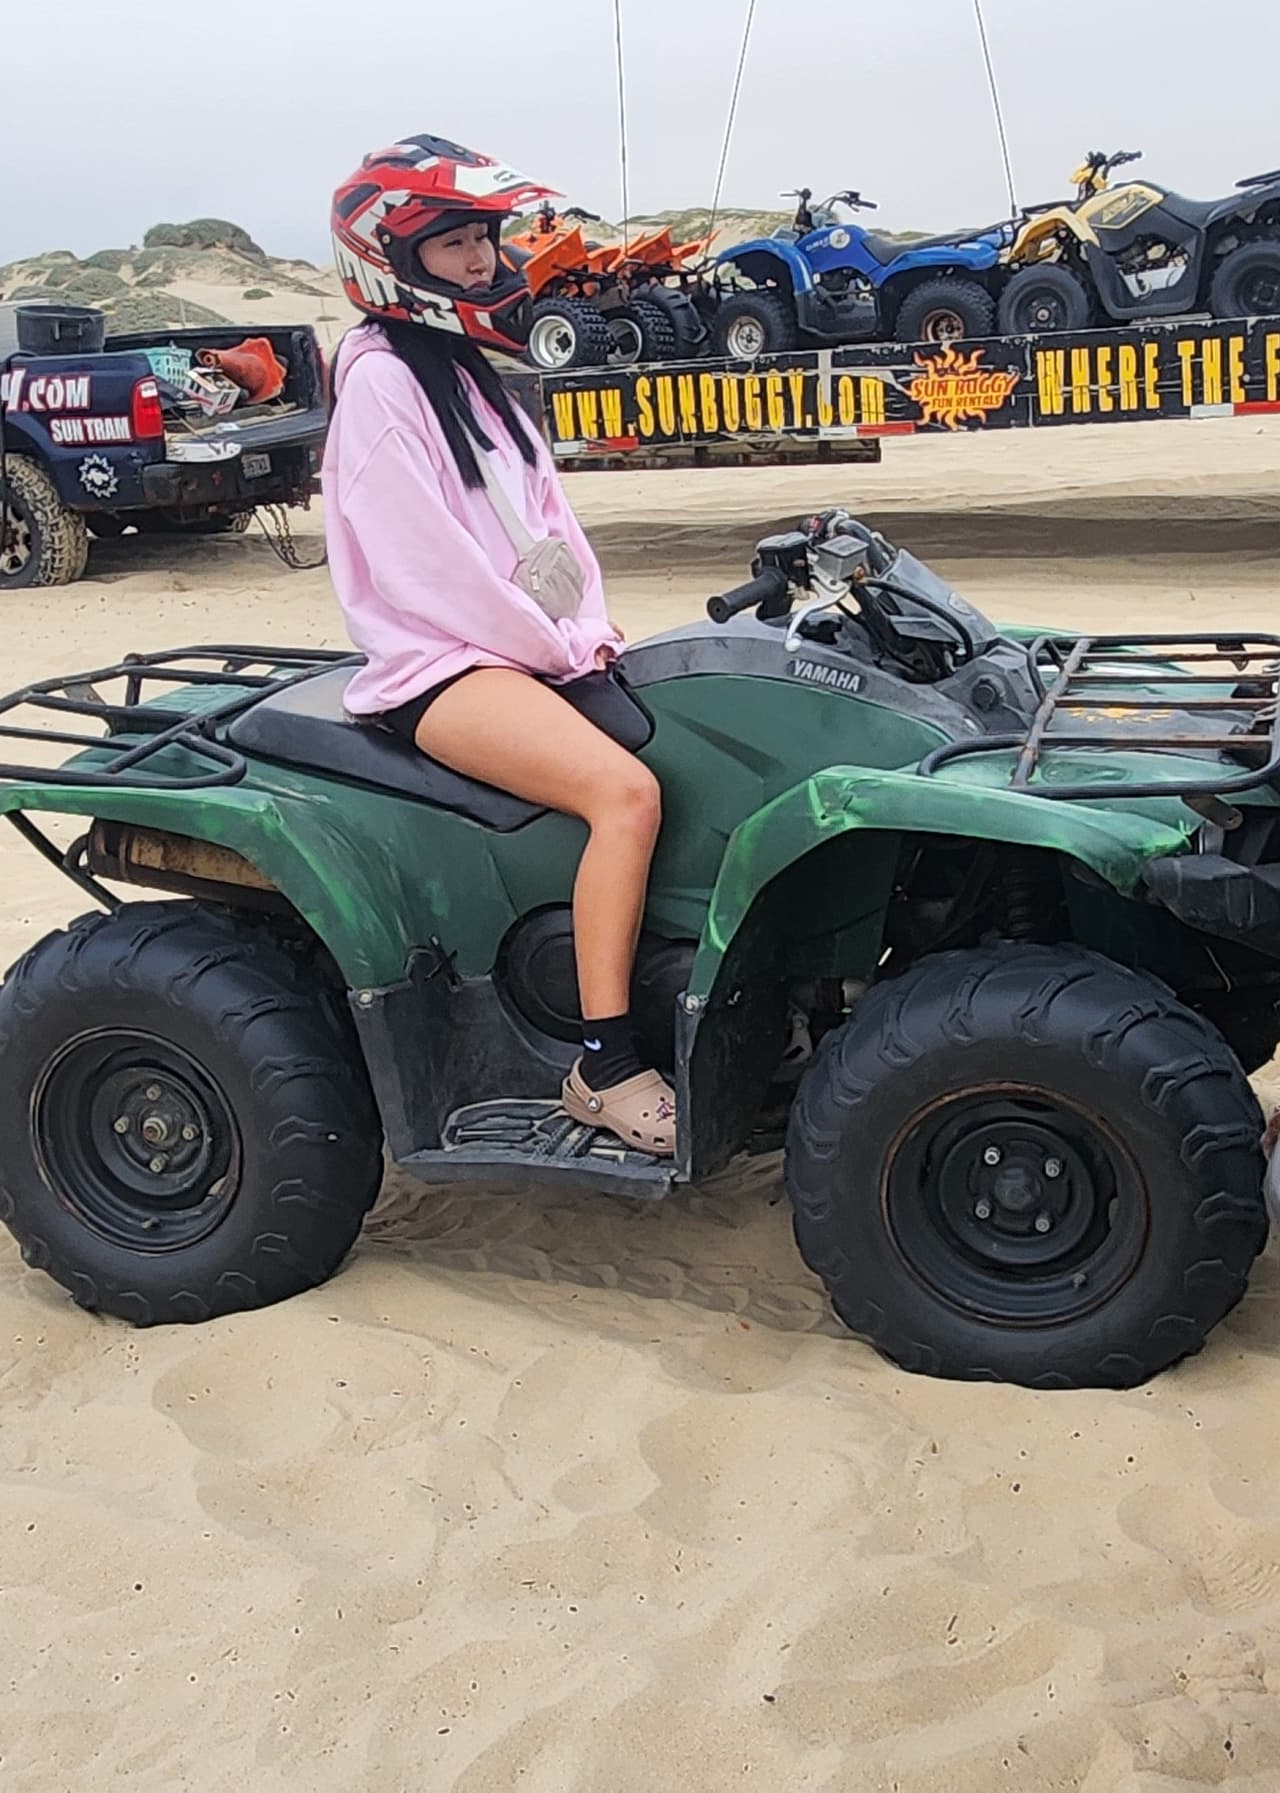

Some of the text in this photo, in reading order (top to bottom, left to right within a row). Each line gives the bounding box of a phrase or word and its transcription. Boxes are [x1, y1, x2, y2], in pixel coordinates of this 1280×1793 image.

[911, 374, 1016, 398] SUN BUGGY
[1036, 343, 1160, 415] WHERE
[1177, 336, 1246, 406] THE
[932, 395, 1001, 408] FUN RENTALS
[50, 416, 131, 442] SUN TRAM
[792, 659, 861, 692] YAMAHA
